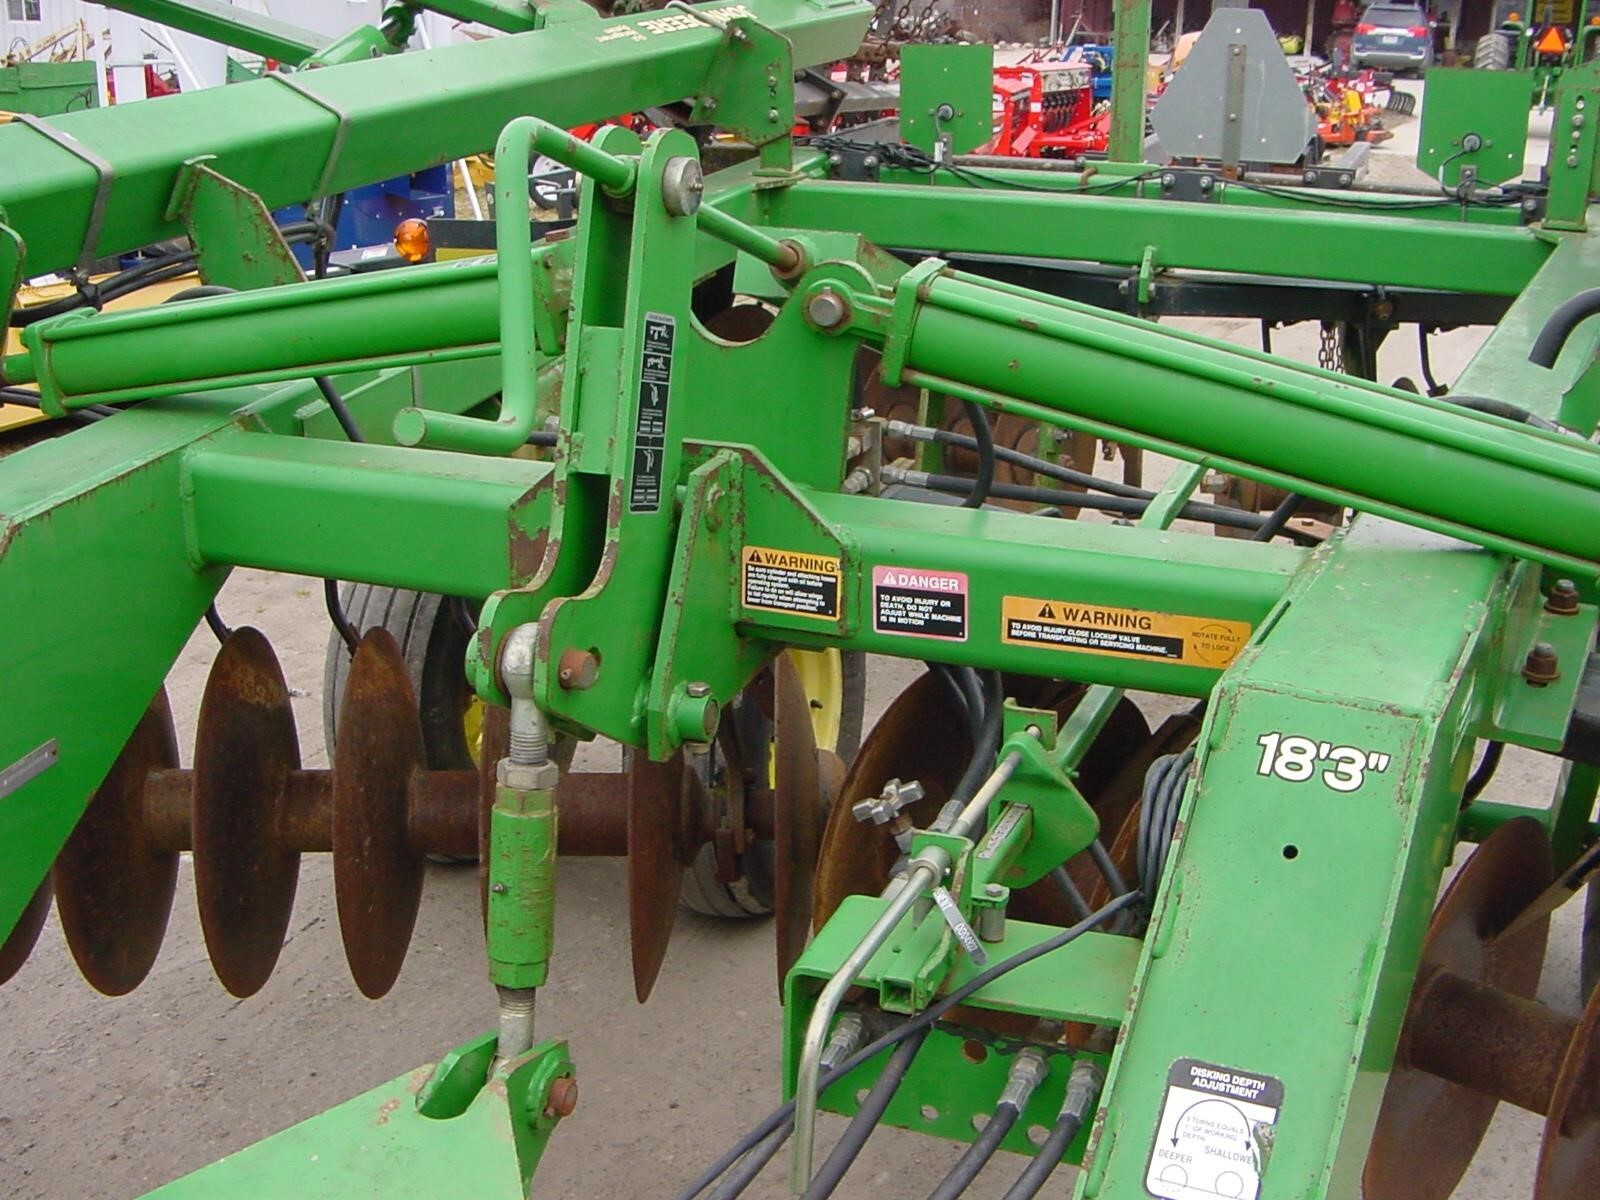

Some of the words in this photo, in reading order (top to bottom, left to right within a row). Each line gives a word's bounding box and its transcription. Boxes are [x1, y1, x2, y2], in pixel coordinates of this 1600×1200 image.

[764, 552, 835, 572] WARNING
[898, 574, 959, 590] DANGER
[880, 602, 905, 611] DEATH,
[892, 595, 913, 604] AVOID
[914, 598, 939, 606] INJURY
[880, 609, 906, 617] ADJUST
[908, 611, 930, 620] WHILE
[931, 614, 962, 623] MACHINE
[898, 618, 924, 626] MOTION
[1063, 607, 1152, 630] WARNING
[1011, 630, 1036, 638] BEFORE
[1038, 632, 1088, 644] TRANSPORTING
[1100, 639, 1134, 650] SERVICING
[1022, 624, 1042, 632] AVOID
[1043, 626, 1066, 635] INJURY
[1068, 628, 1090, 638] CLOSE
[1091, 631, 1118, 640] LOCKUP
[1118, 634, 1140, 644] VALVE
[1192, 632, 1218, 640] ROTATE
[1220, 633, 1240, 642] FULLY
[1212, 643, 1230, 651] LOCK
[1257, 731, 1391, 793] 18'3"
[1190, 1066, 1230, 1082] DISKING
[1232, 1074, 1266, 1090] DEPTH
[1192, 1078, 1260, 1099] ADJUSTMENT
[1191, 1116, 1215, 1128] TURNS
[1216, 1121, 1244, 1134] EQUALS
[1192, 1125, 1202, 1133] OF
[1204, 1129, 1238, 1142] WORKING
[1182, 1131, 1206, 1142] DEPTH
[1158, 1148, 1192, 1164] DEEPER
[1204, 1145, 1254, 1165] SHALLOWE
